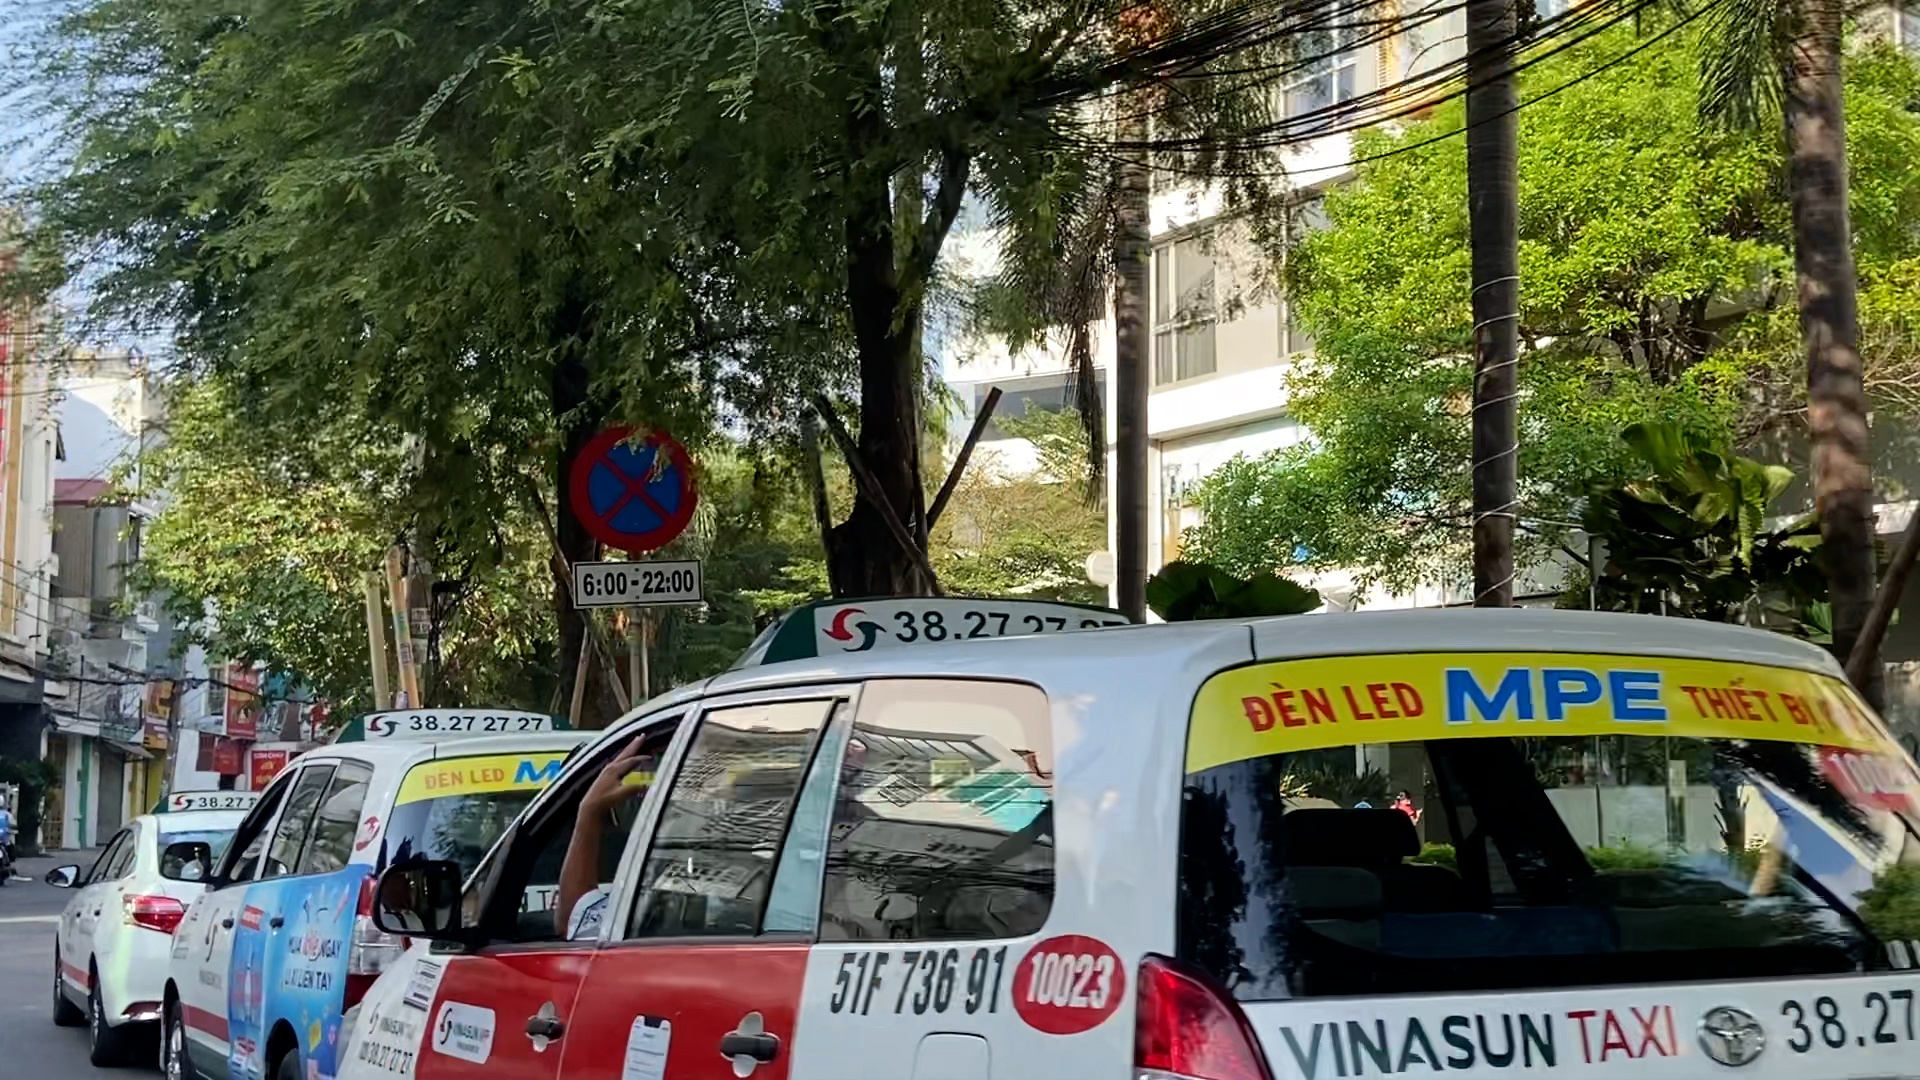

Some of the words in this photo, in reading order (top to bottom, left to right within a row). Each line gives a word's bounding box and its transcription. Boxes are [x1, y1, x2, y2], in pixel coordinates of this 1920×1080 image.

[894, 611, 1010, 642] 38.27
[409, 715, 476, 732] 38.27
[483, 716, 510, 732] 27
[517, 717, 544, 732] 27
[1241, 681, 1338, 732] ĐÈN
[1341, 683, 1424, 721] LED
[1444, 667, 1669, 724] MPE
[1679, 677, 1779, 723] THIẾT
[198, 797, 244, 808] 38.27
[470, 768, 505, 784] LED
[830, 952, 889, 1016] 51F
[893, 947, 960, 1016] 736
[965, 945, 1008, 1015] 91
[1027, 951, 1116, 1009] 10023
[1279, 1013, 1556, 1080] VINASUN
[1565, 1005, 1678, 1064] TAXI
[1781, 989, 1914, 1054] 38.27
